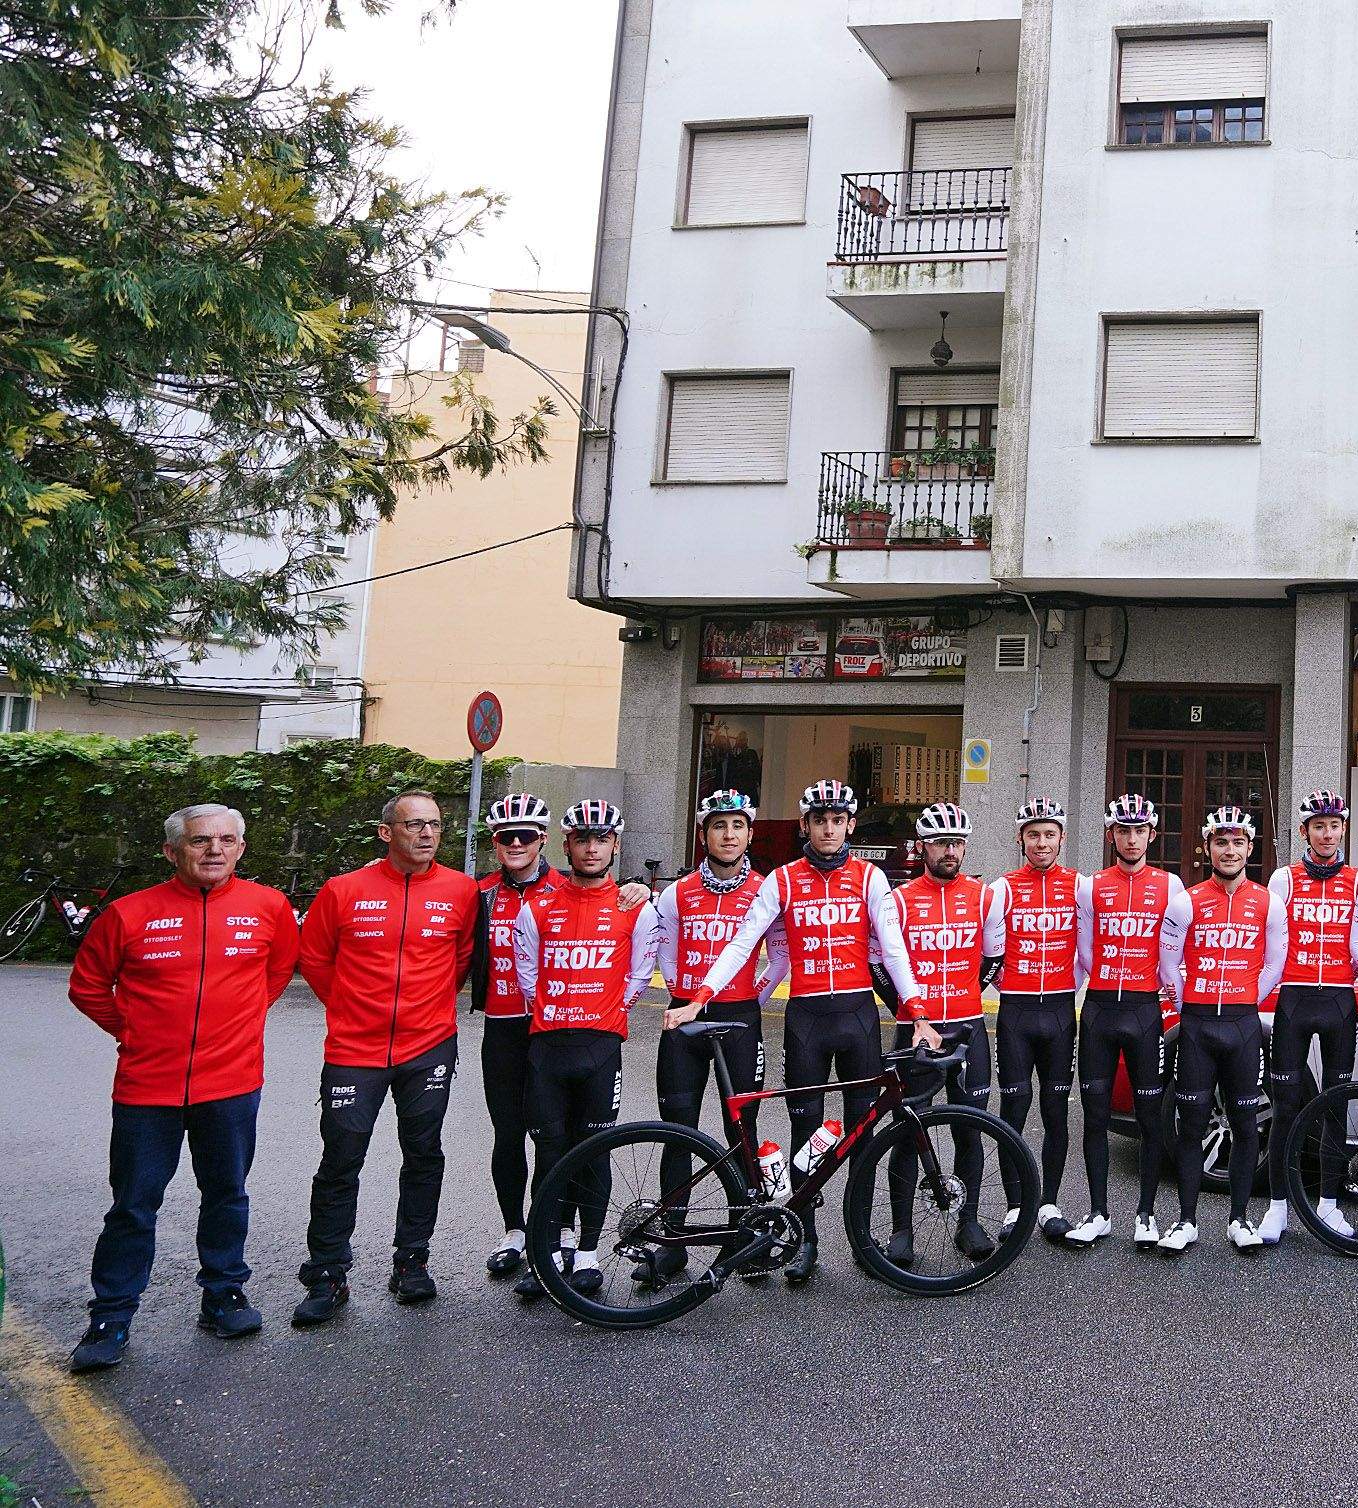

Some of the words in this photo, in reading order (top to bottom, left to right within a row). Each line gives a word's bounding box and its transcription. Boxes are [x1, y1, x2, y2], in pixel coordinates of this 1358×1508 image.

[911, 636, 950, 649] GRUPO
[844, 656, 865, 665] FROIZ
[900, 653, 962, 667] DEPORTIVO
[1193, 708, 1200, 720] 3
[354, 900, 387, 910] FROIZ
[793, 896, 862, 906] supermercados
[1013, 906, 1074, 914] supermercados
[1293, 904, 1351, 924] FROIZ
[430, 915, 445, 923] BH
[793, 904, 862, 927] FROIZ
[144, 917, 183, 932] FROIZ
[909, 921, 977, 930] supermercados
[1012, 913, 1074, 932] FROIZ
[1099, 918, 1158, 937] FROIZ
[1195, 923, 1260, 931] supermercados
[234, 932, 252, 940] BH
[353, 930, 384, 938] ABANCA
[1194, 928, 1259, 950] FROIZ
[143, 935, 183, 944] OTTOBOSLEY
[545, 939, 616, 947] supermercados
[909, 928, 978, 951] FROIZ
[143, 950, 181, 960] ABANCA
[544, 947, 616, 970] FROIZ
[816, 958, 843, 966] XUNTA
[983, 961, 1000, 983] FROIZ
[930, 984, 955, 992] XUNTA
[941, 989, 968, 997] GALICIA
[1218, 986, 1246, 994] GALICIA
[624, 990, 642, 1010] ROIZ
[569, 1013, 601, 1021] GALICIA
[754, 1040, 765, 1082] FROIZ
[332, 1086, 356, 1094] FROIZ
[611, 1070, 622, 1110] FROIZ
